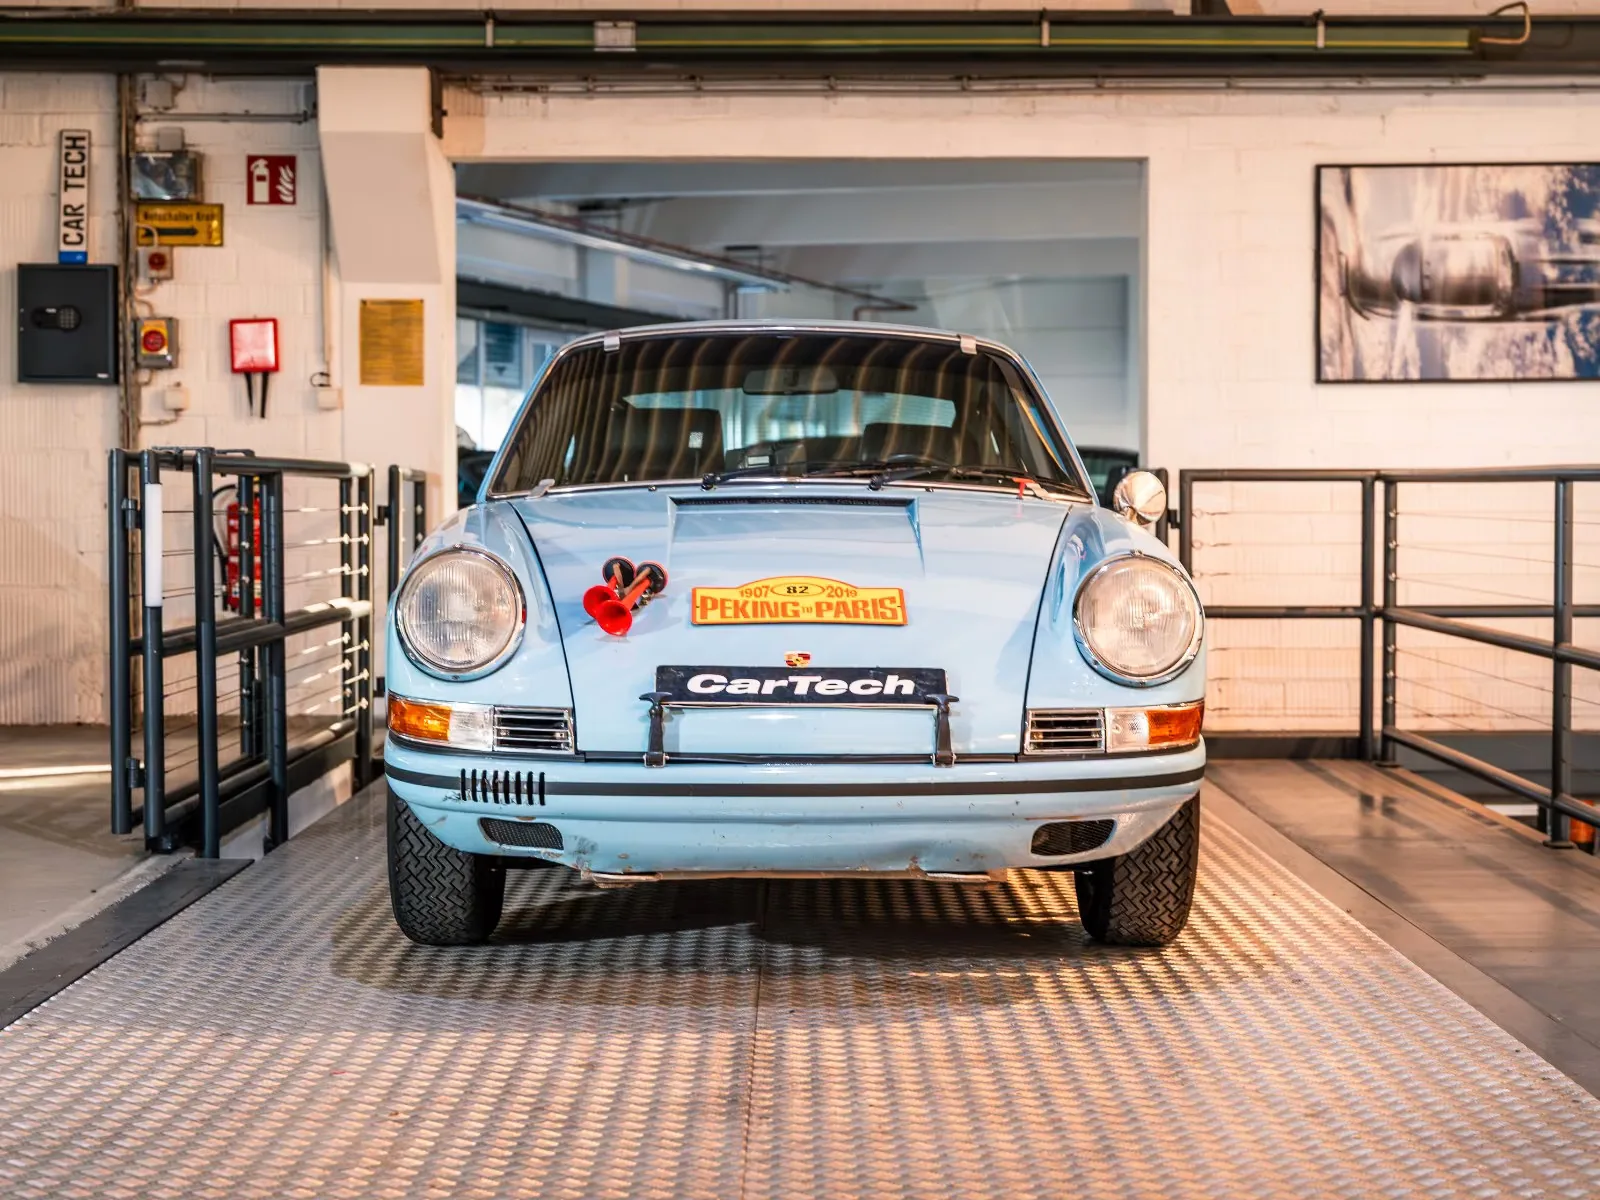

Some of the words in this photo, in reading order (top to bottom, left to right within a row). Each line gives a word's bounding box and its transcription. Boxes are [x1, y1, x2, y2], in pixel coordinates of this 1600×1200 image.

[64, 135, 86, 192] TECH
[62, 204, 85, 246] CAR
[739, 585, 769, 598] 1907
[786, 585, 809, 594] 82
[825, 585, 858, 598] 2019
[700, 596, 800, 620] PEKING
[815, 596, 898, 620] PARIS
[687, 674, 915, 696] CarTech
